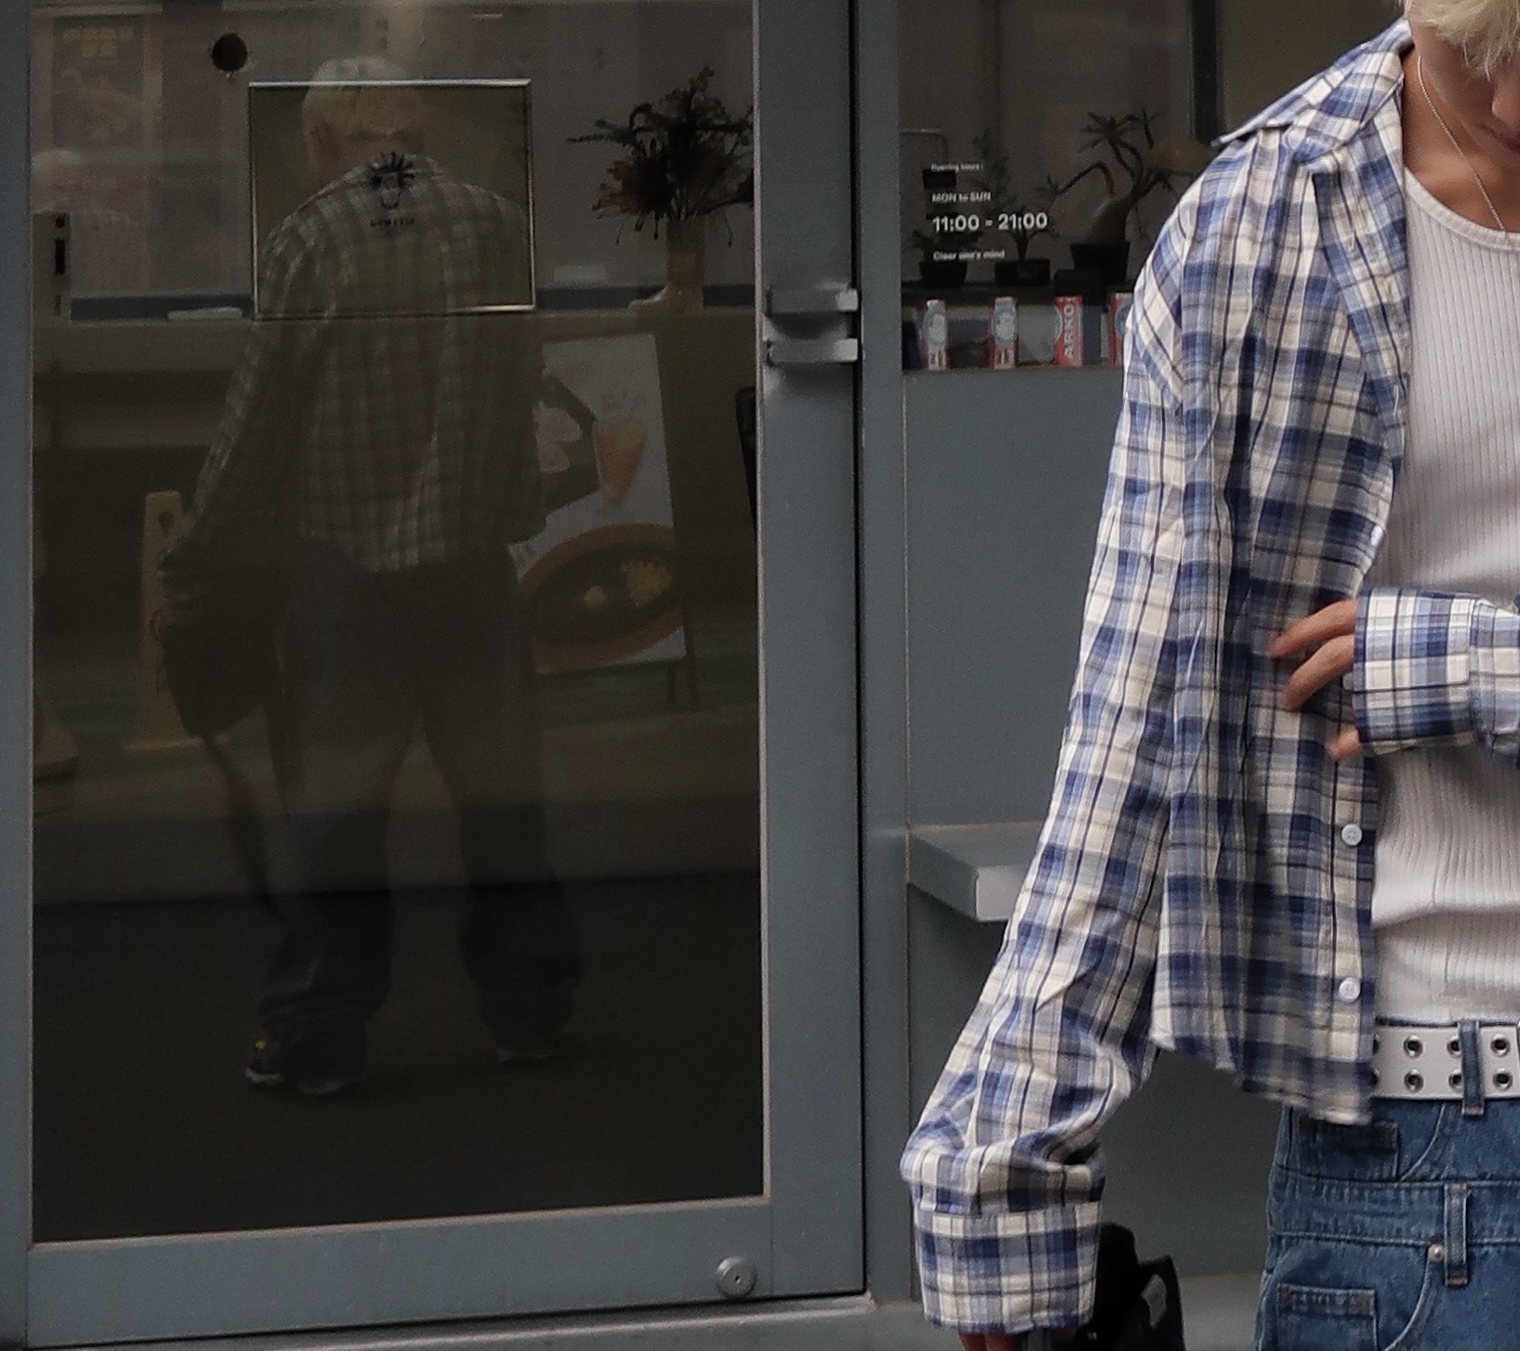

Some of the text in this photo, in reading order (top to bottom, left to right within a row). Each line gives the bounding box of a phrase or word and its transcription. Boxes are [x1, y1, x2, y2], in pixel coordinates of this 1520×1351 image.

[931, 193, 957, 204] MON
[969, 191, 992, 202] SUN
[932, 214, 981, 233] 11:00
[997, 212, 1048, 231] 21:00
